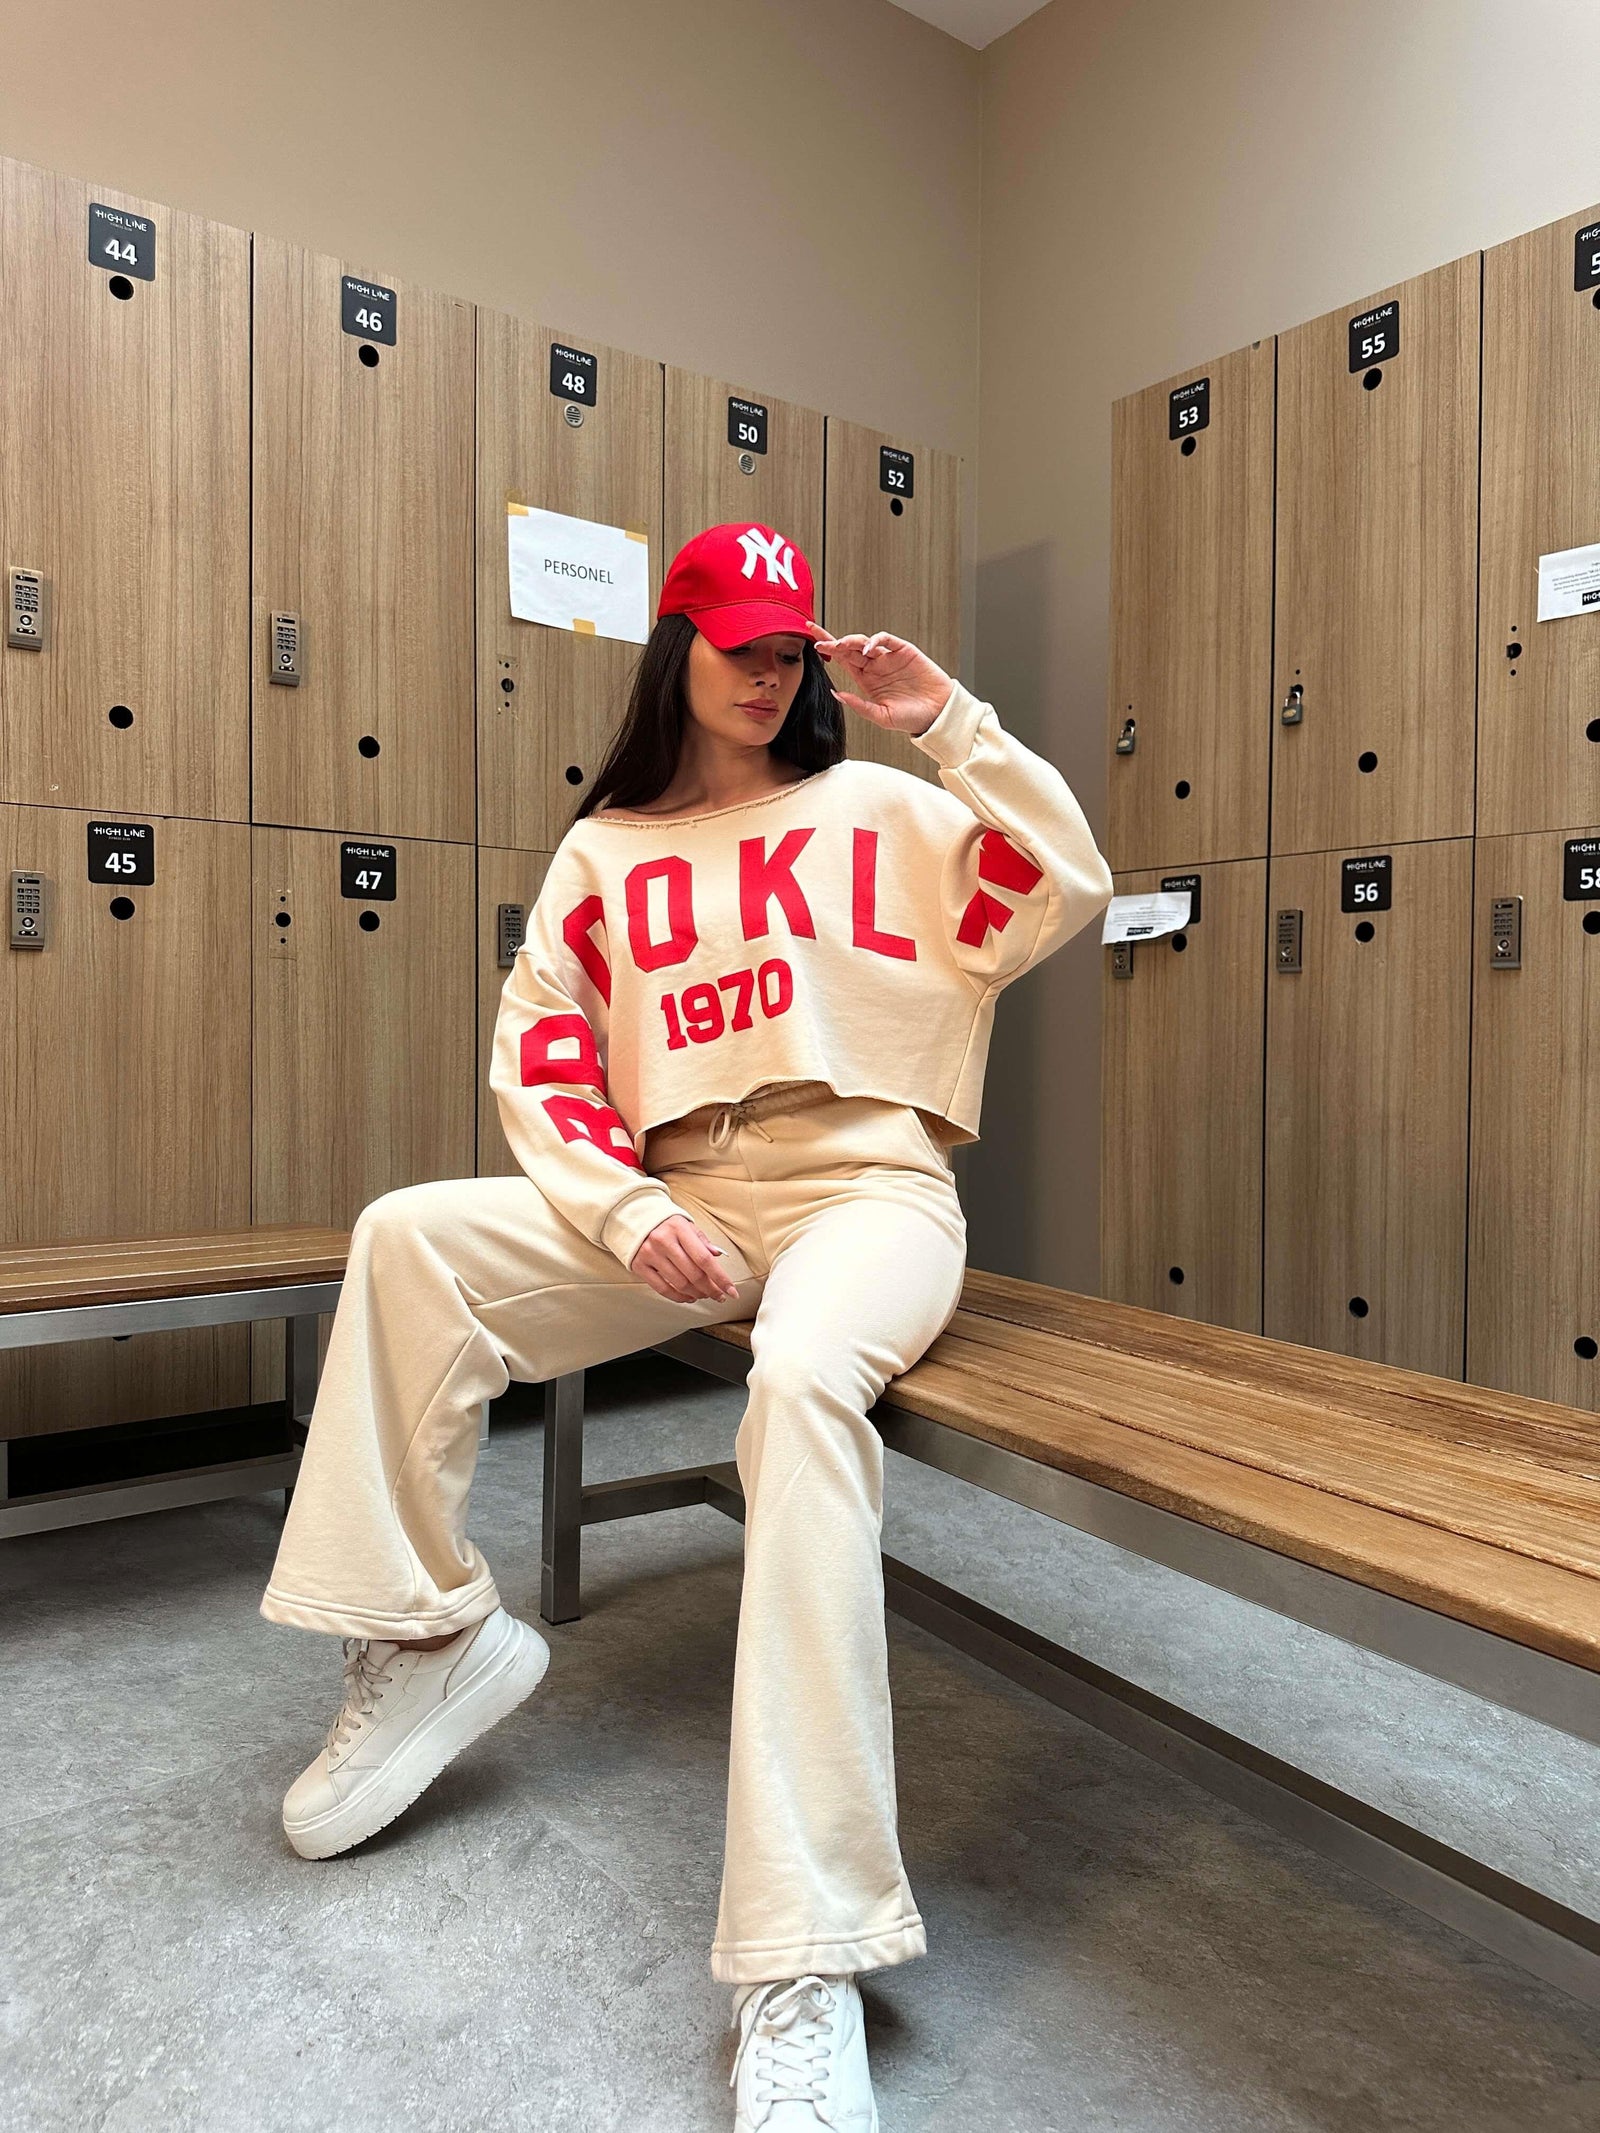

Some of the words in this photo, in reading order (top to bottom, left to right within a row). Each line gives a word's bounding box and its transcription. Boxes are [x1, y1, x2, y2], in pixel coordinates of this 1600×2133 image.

[95, 209, 123, 225] HIGH
[125, 218, 147, 232] LINE
[1580, 228, 1600, 241] HIG
[105, 239, 138, 265] 44
[346, 281, 370, 295] HIGH
[371, 289, 390, 301] LINE
[355, 308, 382, 332] 46
[1353, 315, 1374, 329] HIGH
[1375, 306, 1393, 321] LINE
[555, 348, 575, 360] HIGH
[1361, 332, 1386, 359] 55
[562, 372, 585, 394] 48
[1179, 406, 1198, 428] 53
[738, 422, 758, 443] 50
[888, 469, 905, 489] 52
[736, 527, 799, 591] NY
[544, 559, 614, 585] PERSONEL
[93, 827, 121, 837] HIGH
[123, 828, 146, 838] LINE
[346, 847, 369, 856] HIGH
[371, 849, 390, 858] LINE
[1570, 843, 1596, 853] HIGH
[105, 852, 137, 874] 45
[355, 870, 382, 890] 47
[1354, 882, 1378, 903] 56
[660, 958, 793, 1051] 1970
